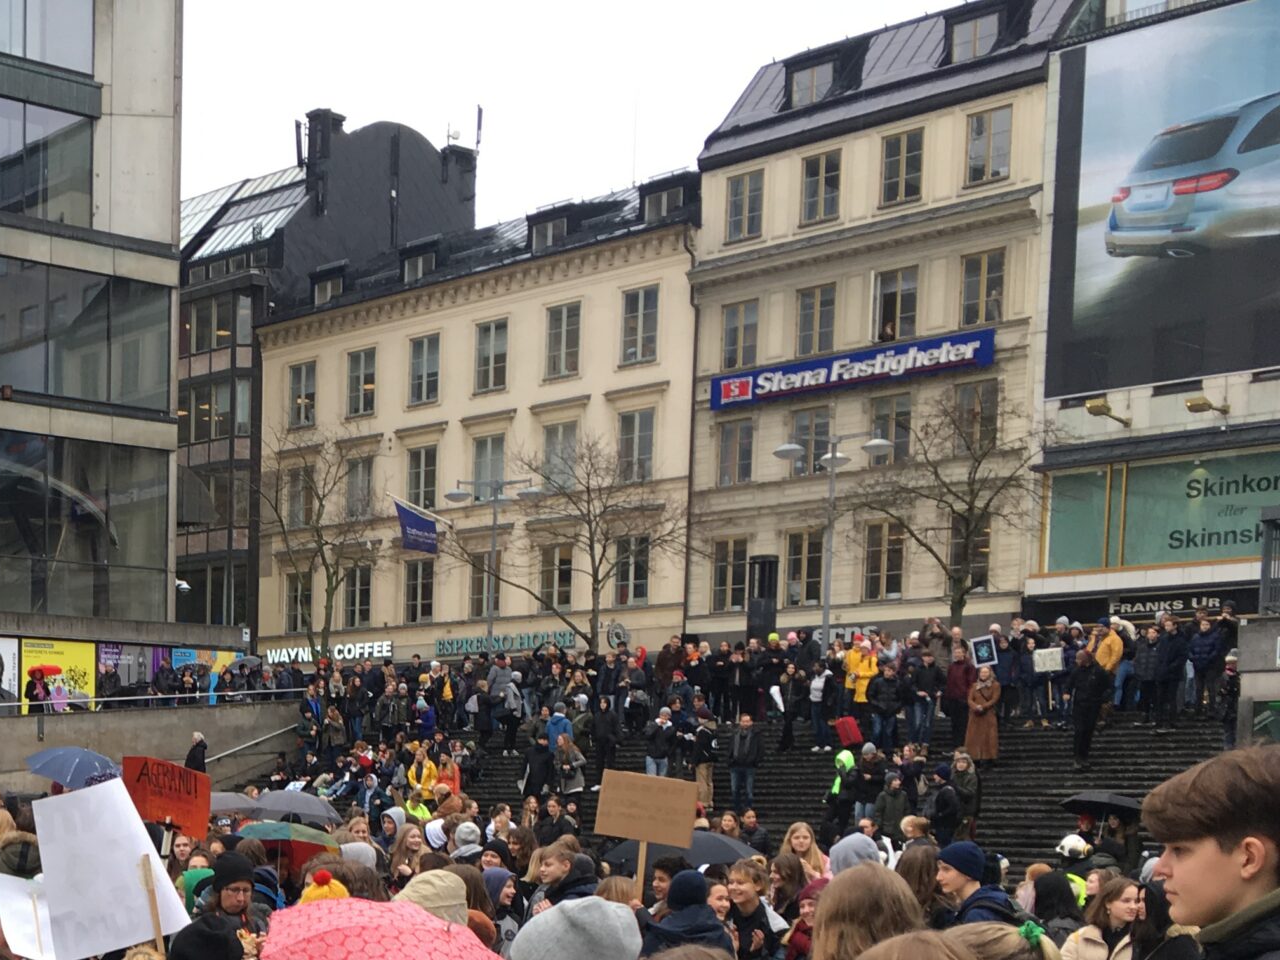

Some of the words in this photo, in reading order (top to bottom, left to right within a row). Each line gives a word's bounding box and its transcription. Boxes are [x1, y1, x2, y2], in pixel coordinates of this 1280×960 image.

[754, 368, 828, 395] Stena
[829, 340, 980, 382] Fastigheter
[1217, 504, 1248, 517] eller
[1108, 599, 1184, 614] FRANKS
[1191, 596, 1221, 609] UR
[333, 640, 392, 660] COFFEE
[435, 635, 513, 656] ESPRESSO
[518, 630, 576, 650] HOUSE
